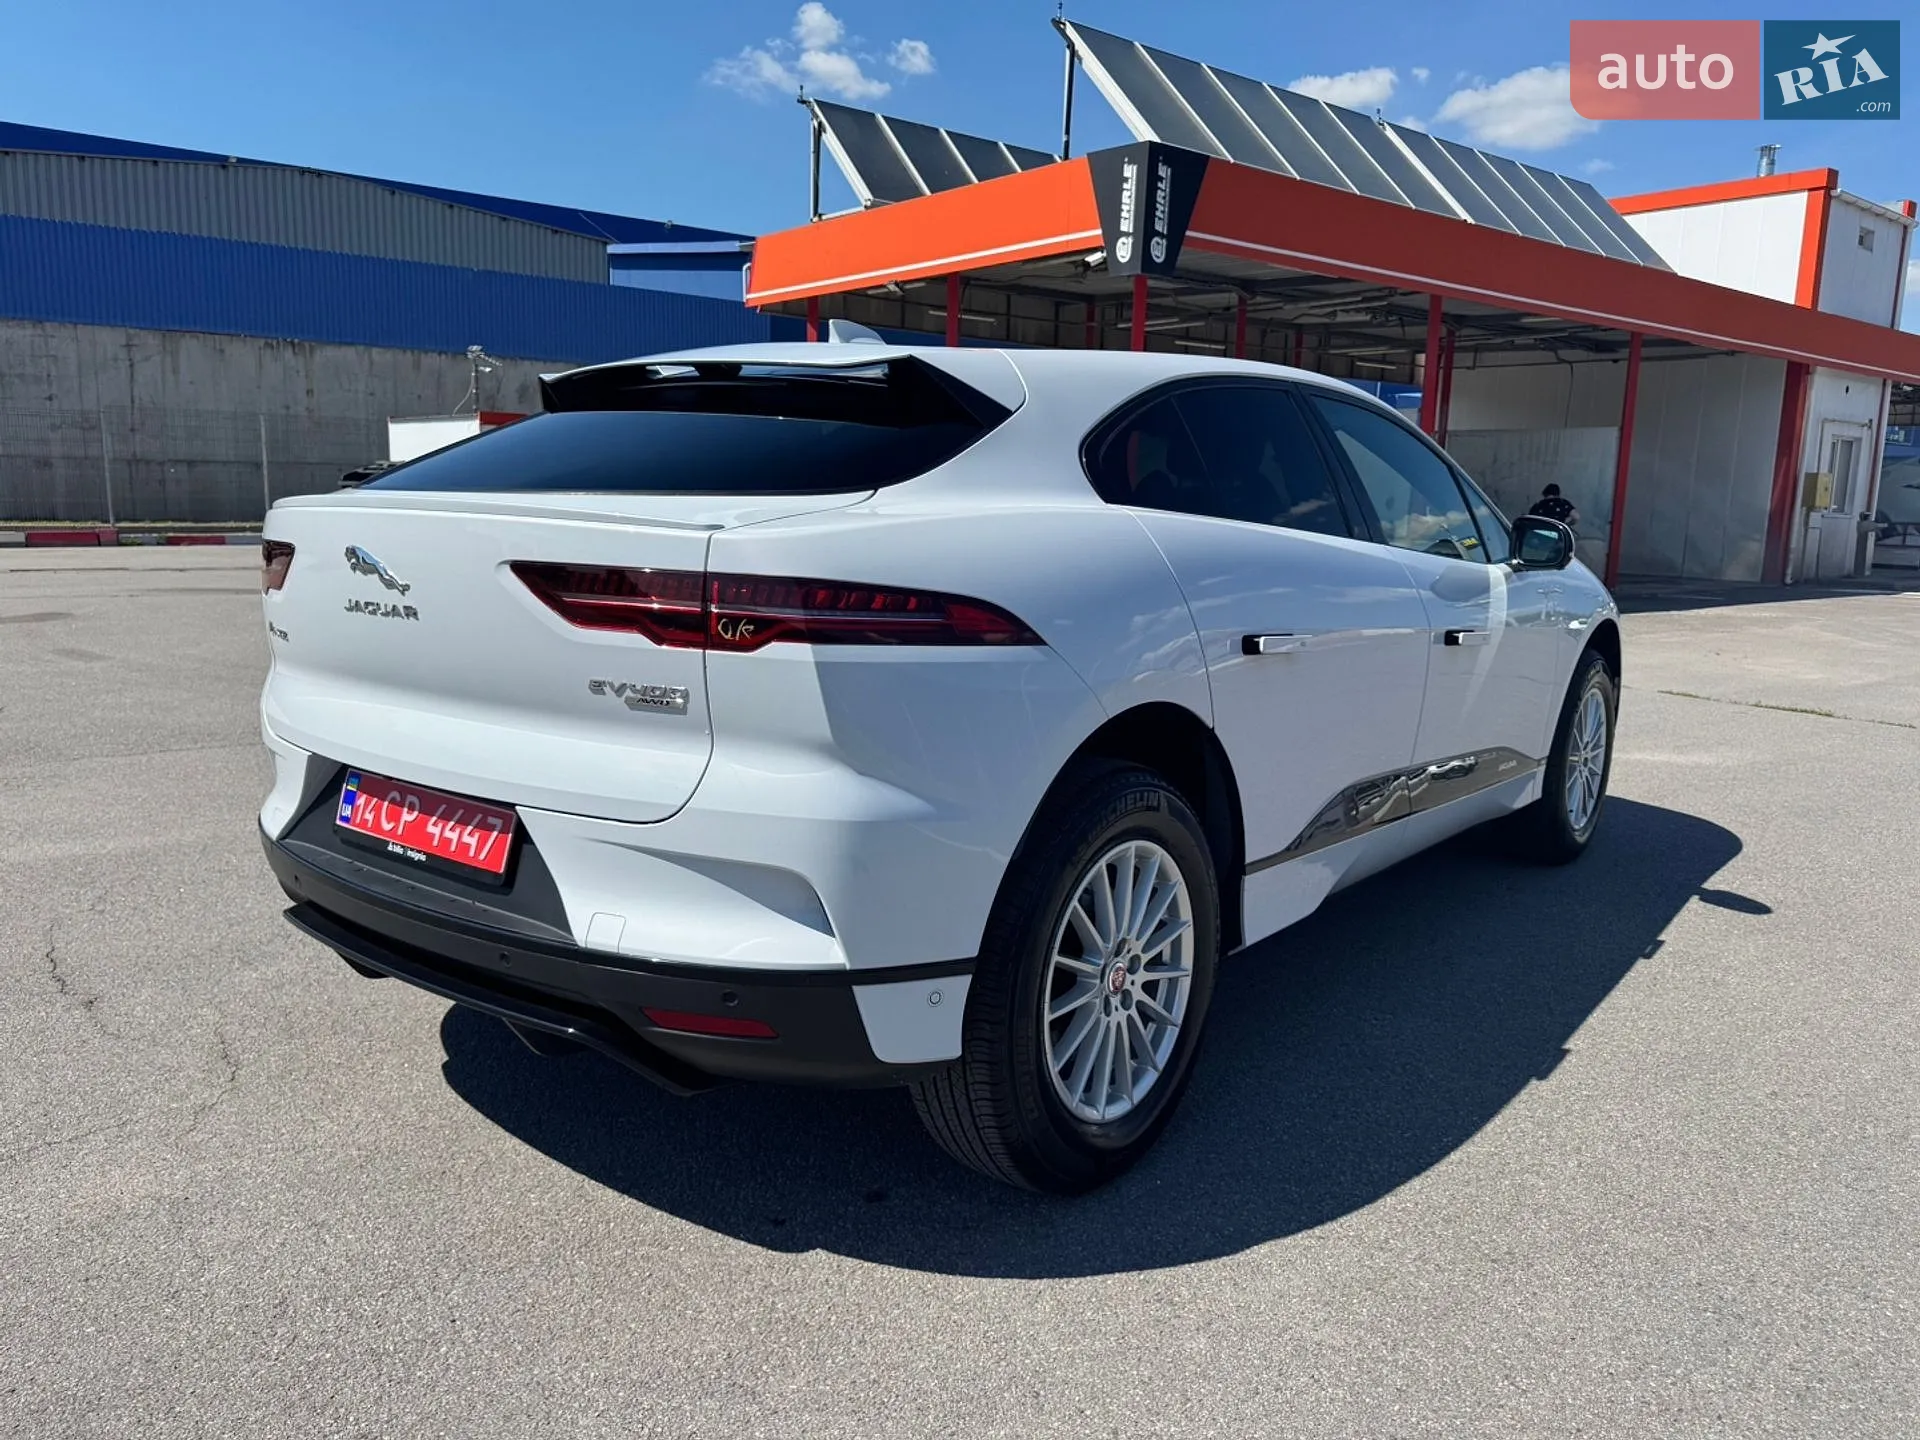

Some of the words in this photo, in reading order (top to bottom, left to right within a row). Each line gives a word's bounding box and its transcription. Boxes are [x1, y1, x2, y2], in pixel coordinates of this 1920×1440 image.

[1120, 162, 1133, 233] EHRLE
[1154, 162, 1169, 234] EHRLE
[343, 599, 420, 621] JAGUAR
[355, 793, 379, 829] 14
[426, 804, 503, 862] 4447
